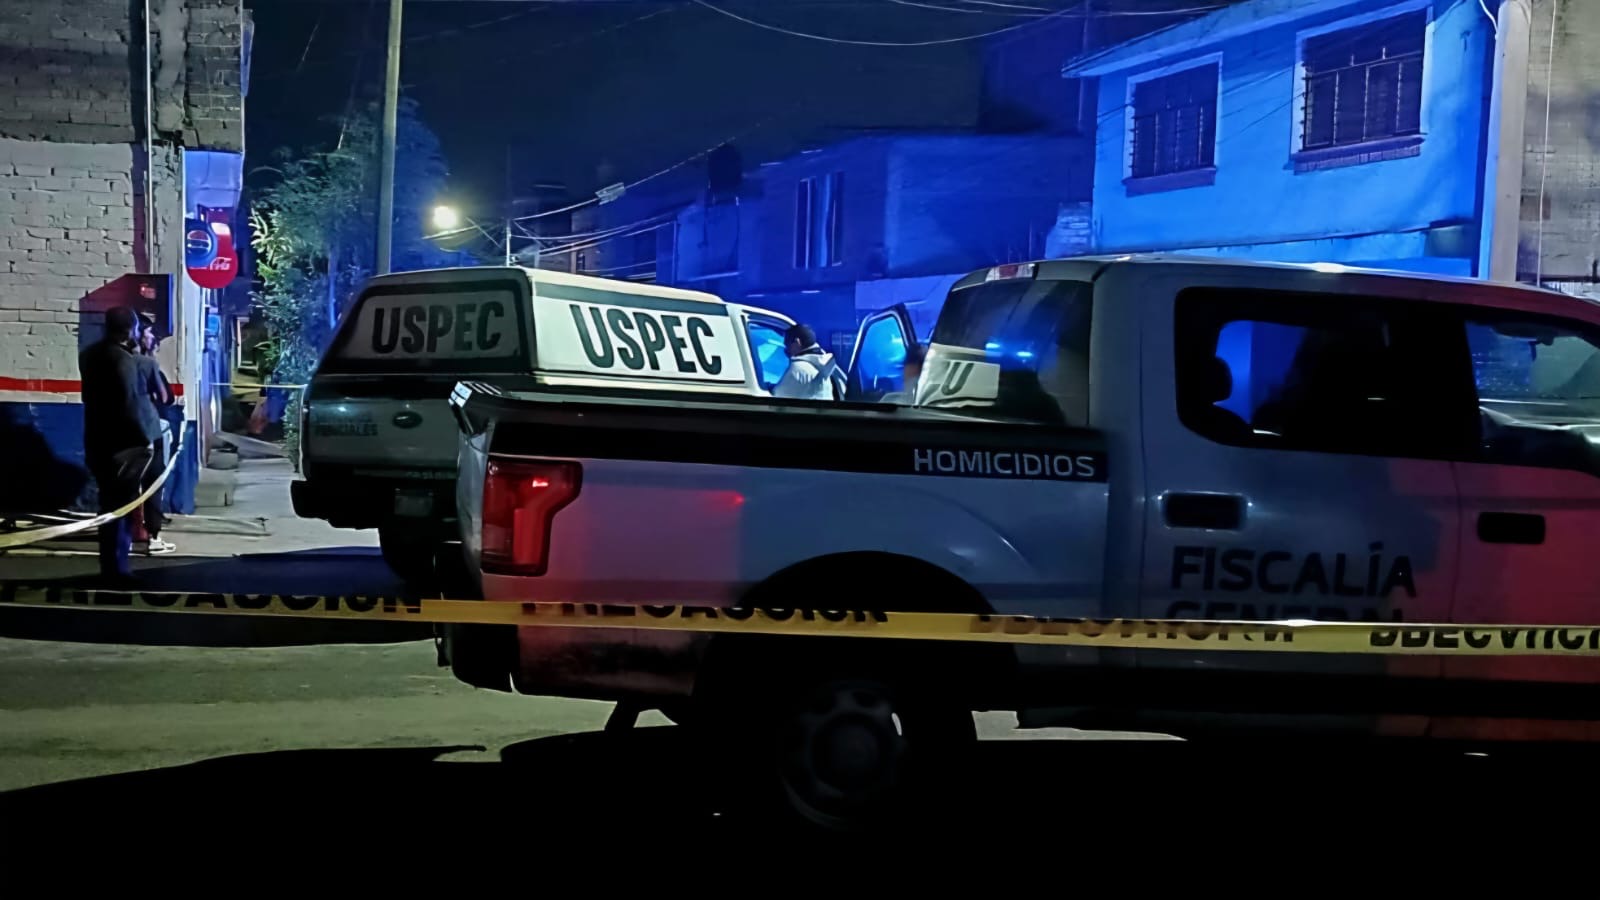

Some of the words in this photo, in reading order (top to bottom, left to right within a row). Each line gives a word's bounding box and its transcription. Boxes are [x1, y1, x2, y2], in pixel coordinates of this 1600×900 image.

[372, 301, 504, 354] USPEC
[569, 303, 722, 375] USPEC
[914, 448, 1095, 477] HOMICIDIOS
[1171, 541, 1417, 597] FISCALÍA
